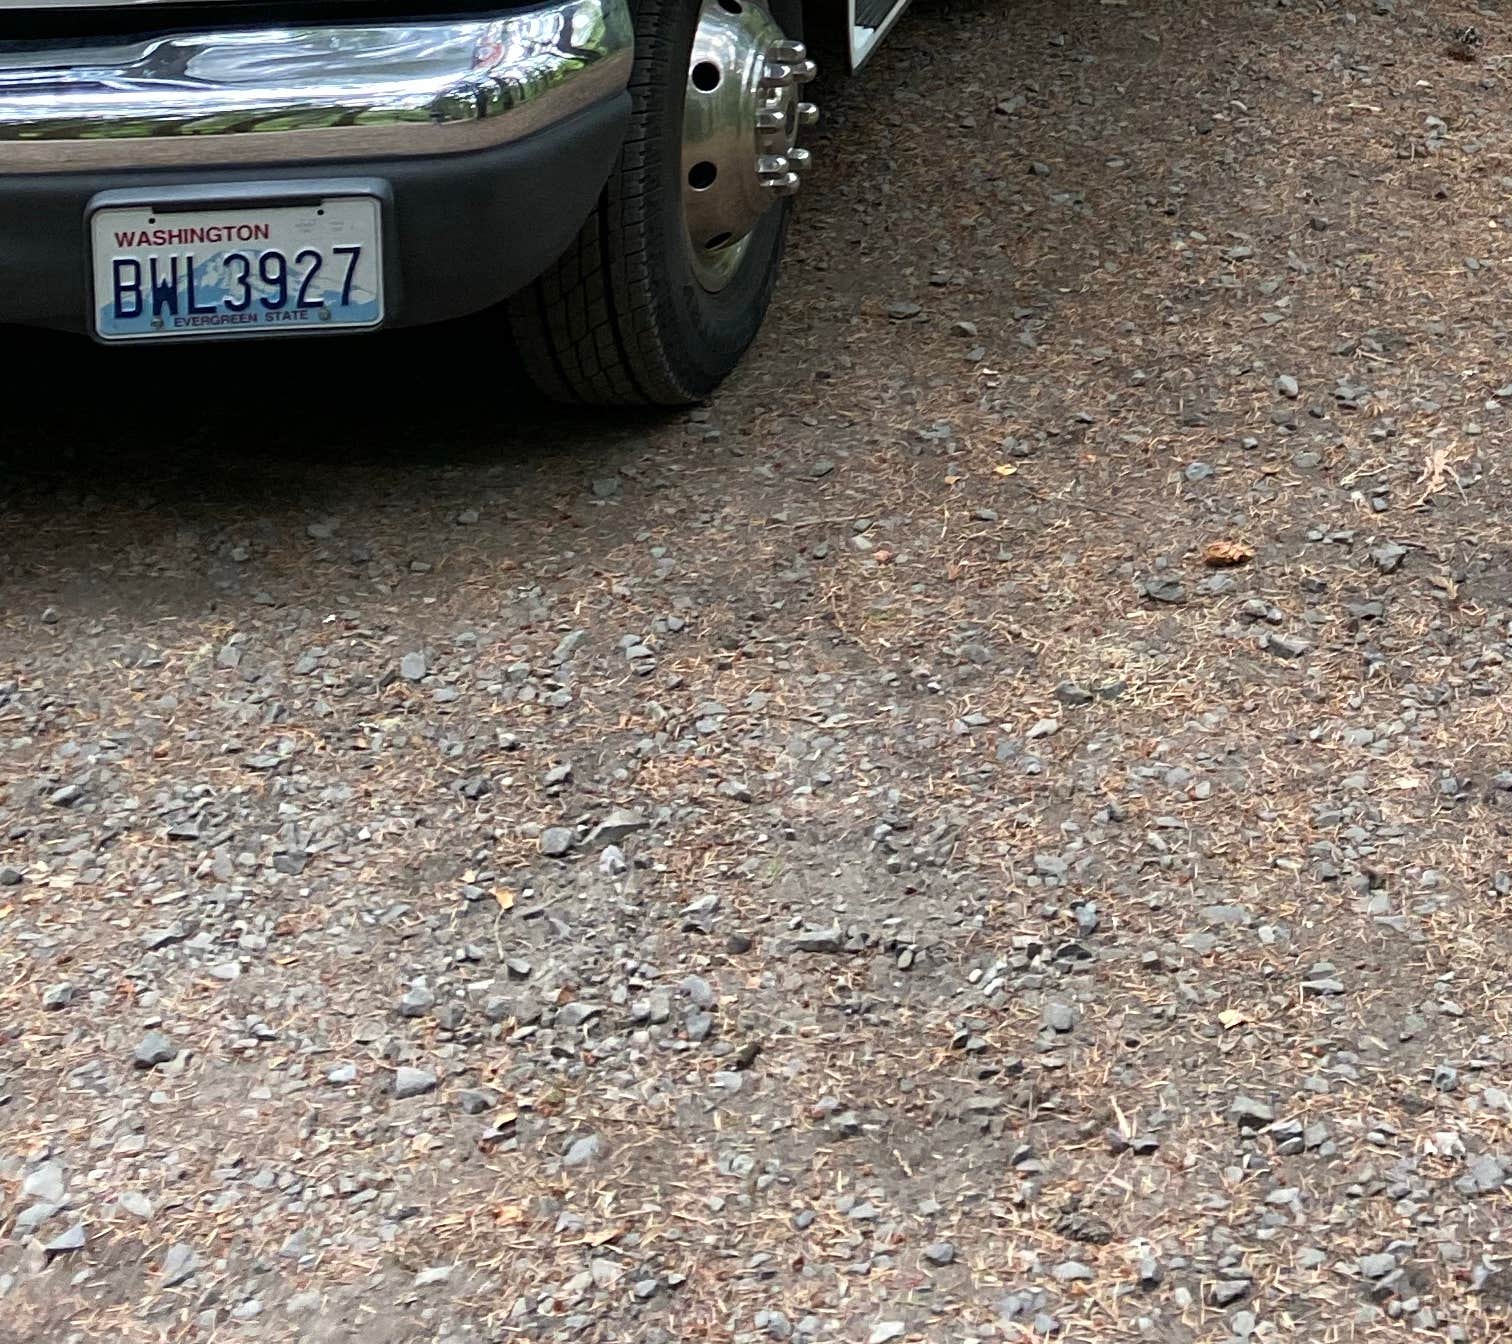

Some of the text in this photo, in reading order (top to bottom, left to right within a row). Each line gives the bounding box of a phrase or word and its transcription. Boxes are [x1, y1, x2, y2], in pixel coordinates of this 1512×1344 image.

[115, 223, 270, 248] WASHINGTON
[112, 245, 362, 318] BWL3927
[173, 310, 309, 327] EVERGREEN STATE
